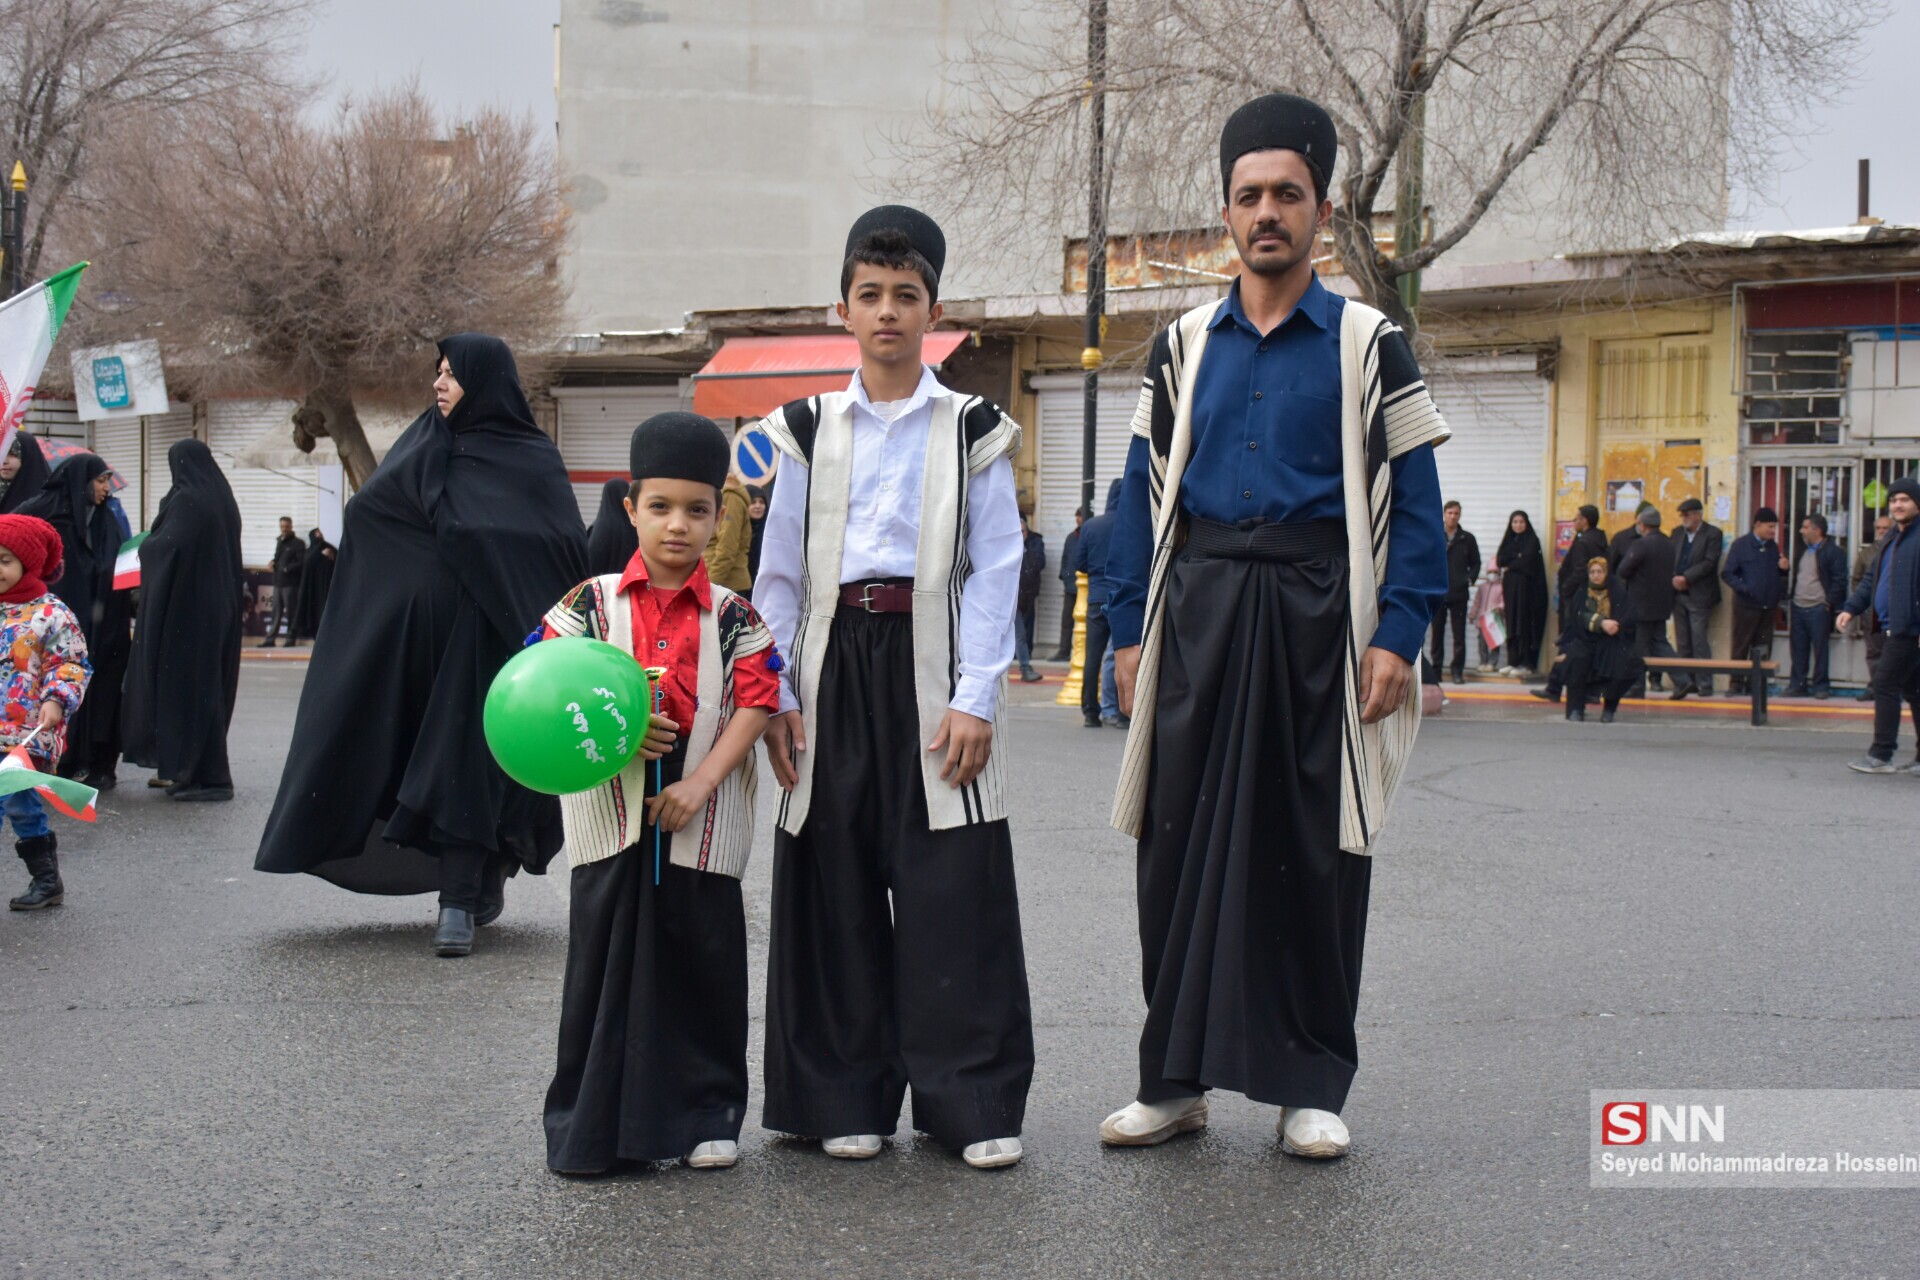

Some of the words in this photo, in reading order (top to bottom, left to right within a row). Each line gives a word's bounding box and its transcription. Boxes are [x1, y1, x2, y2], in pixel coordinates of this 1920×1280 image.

[565, 702, 589, 733] دهه
[576, 738, 606, 763] فجر
[615, 734, 629, 755] باد
